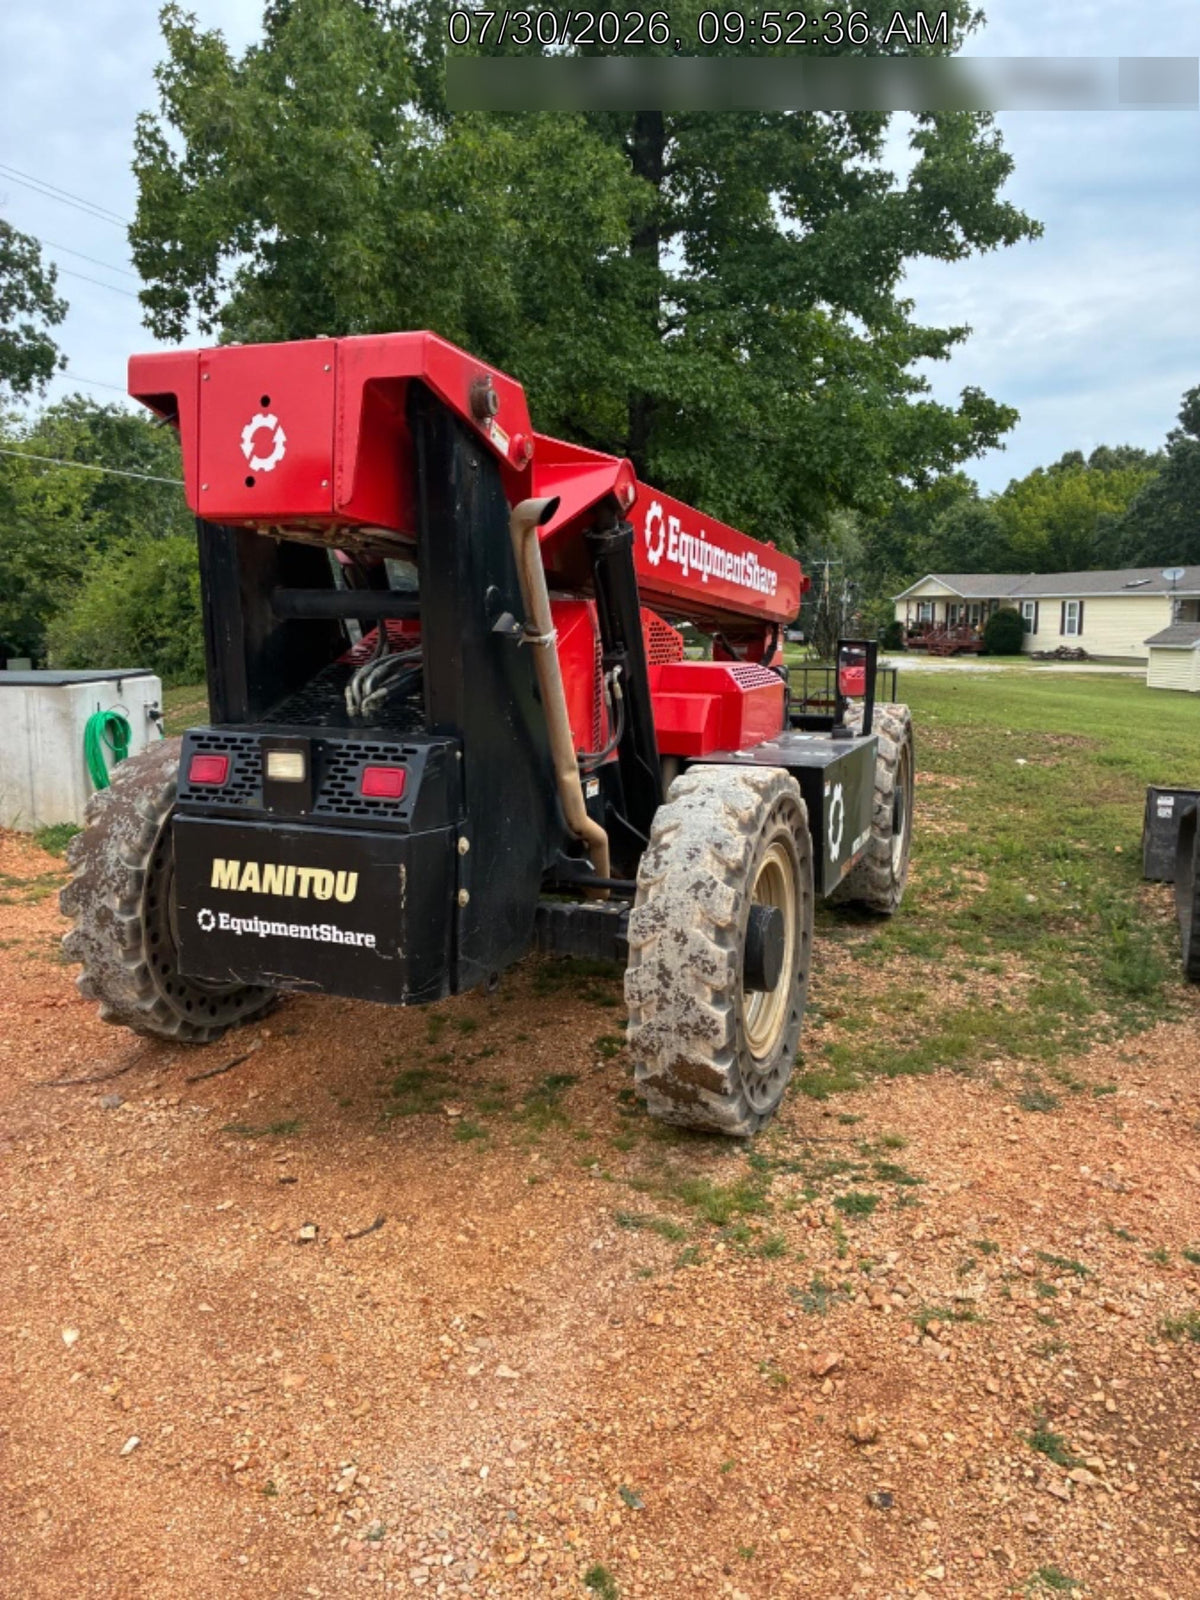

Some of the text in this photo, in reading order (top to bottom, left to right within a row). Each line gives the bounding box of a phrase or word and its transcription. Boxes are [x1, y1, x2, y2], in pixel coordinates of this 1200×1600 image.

[666, 515, 778, 596] EquipmentShare
[210, 858, 359, 903] MANITOU
[218, 912, 376, 948] EquipmentShare
